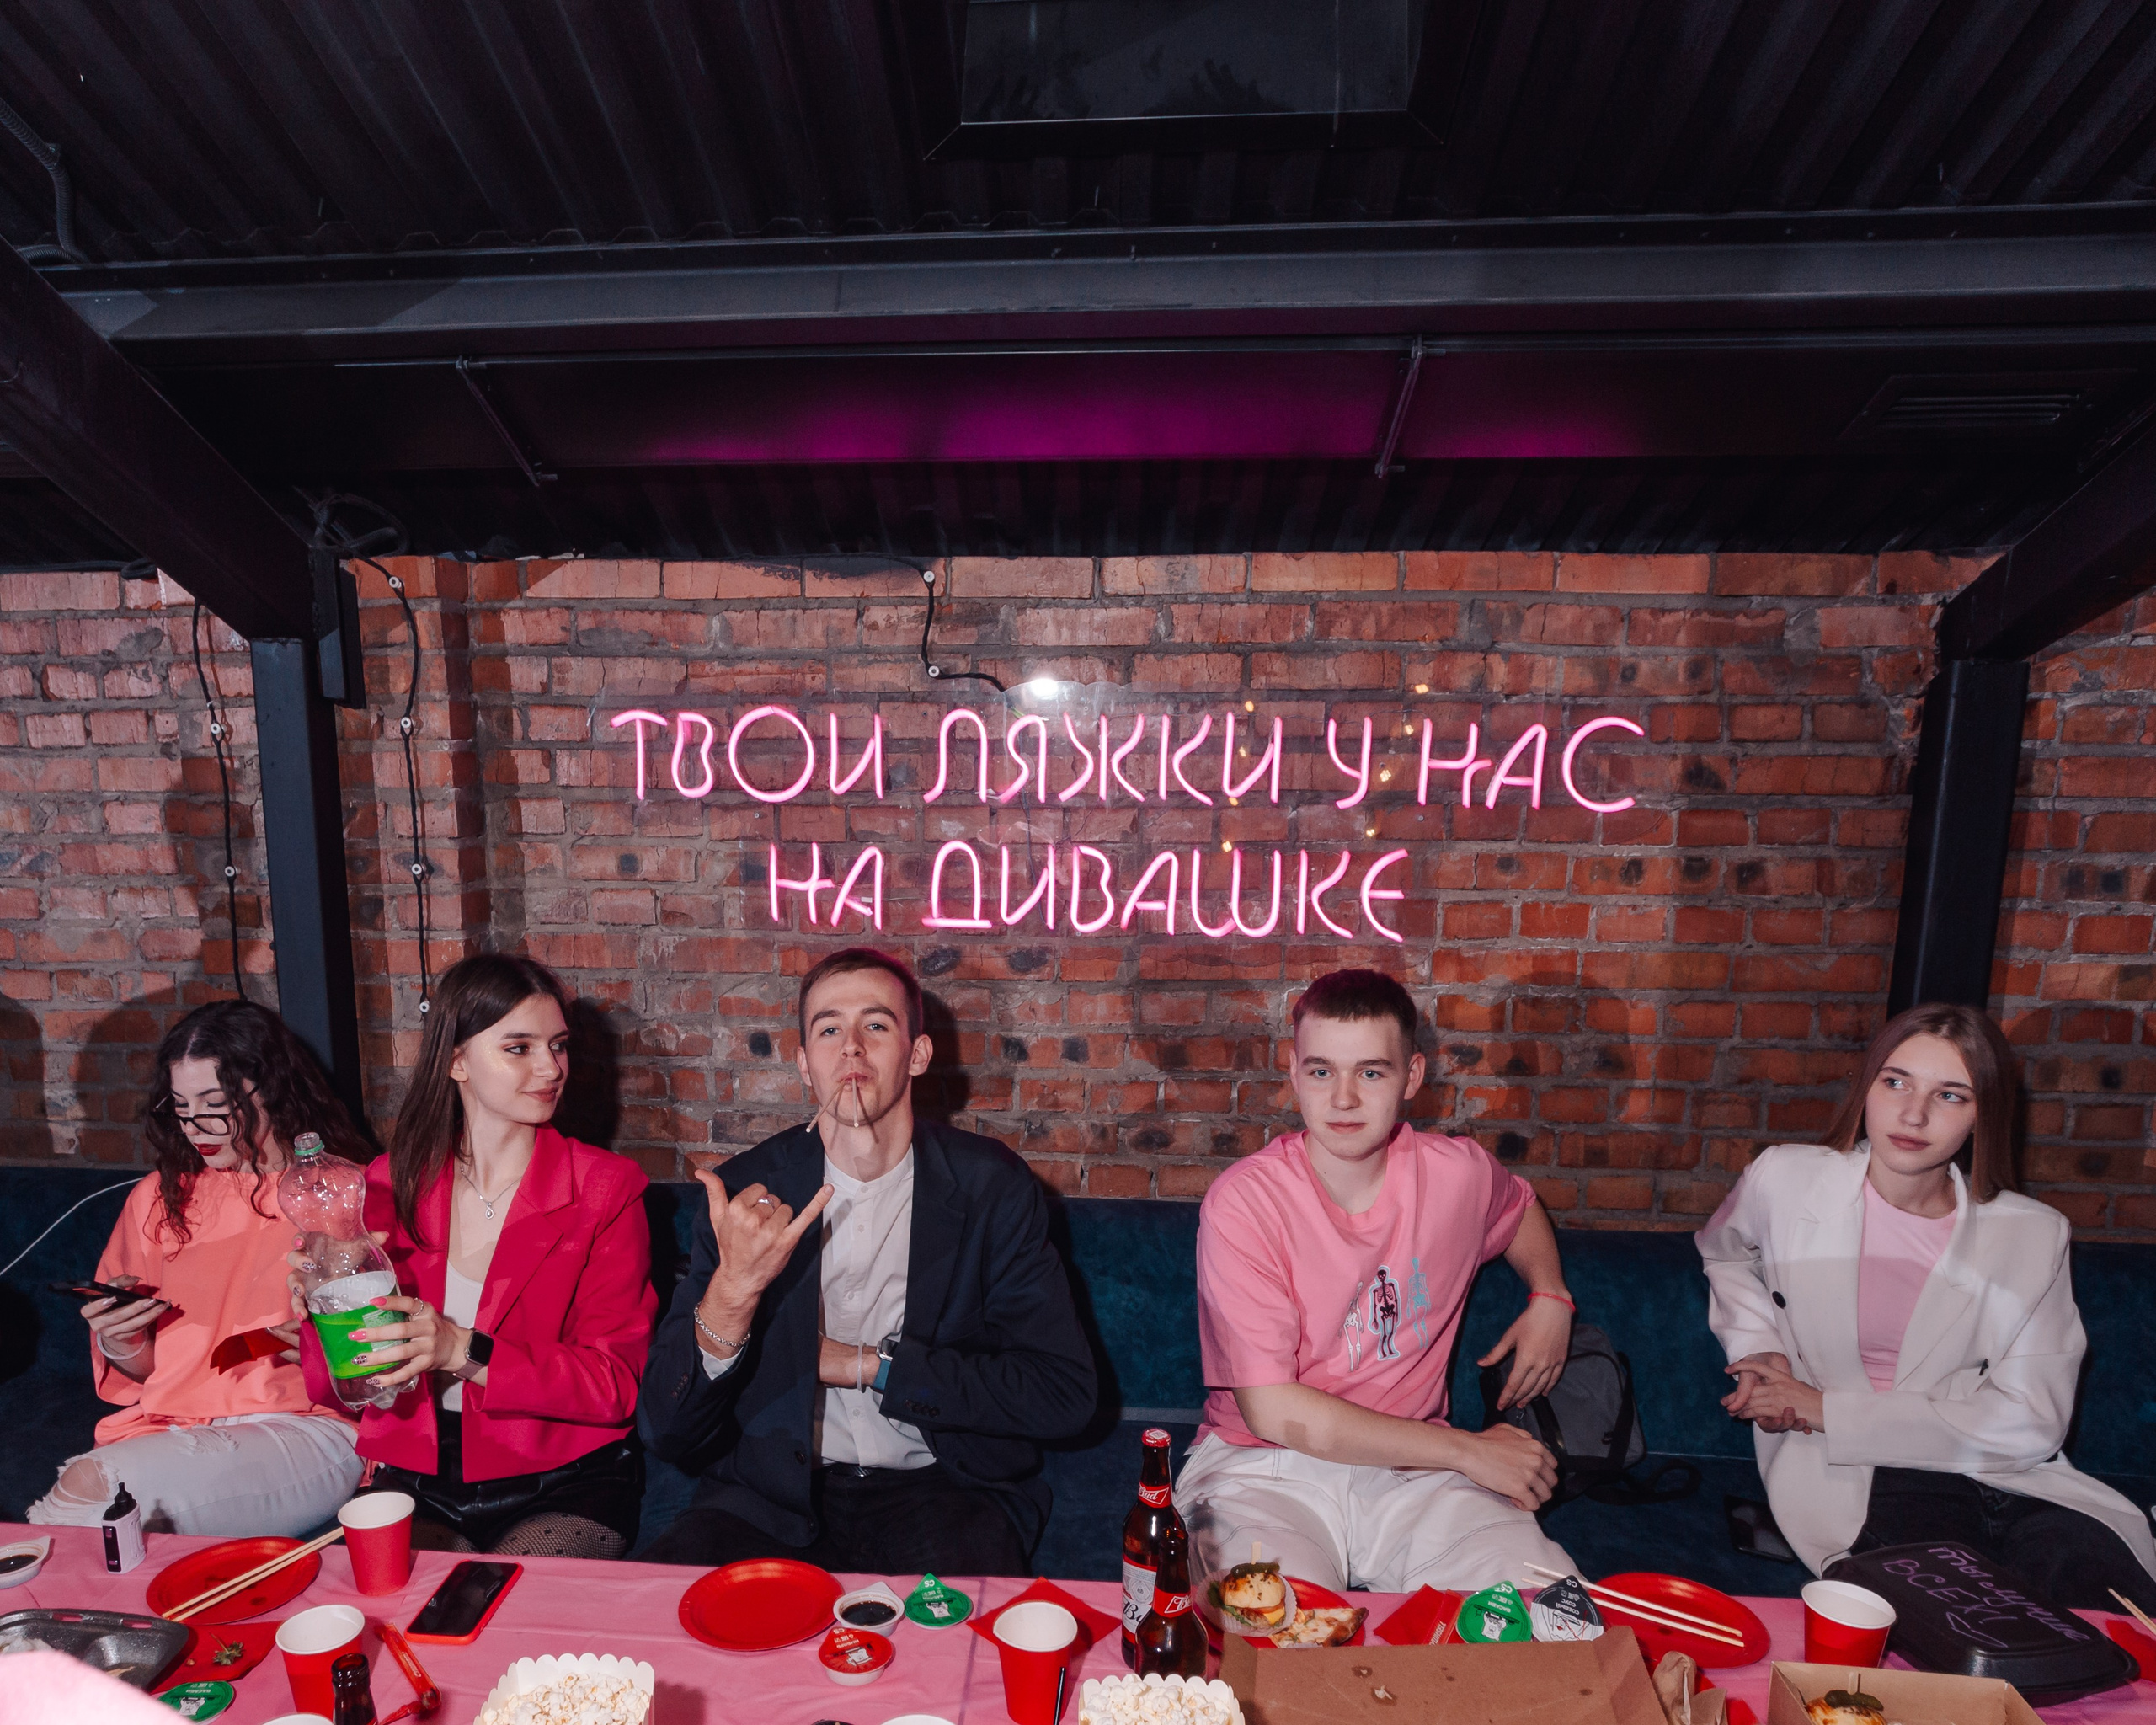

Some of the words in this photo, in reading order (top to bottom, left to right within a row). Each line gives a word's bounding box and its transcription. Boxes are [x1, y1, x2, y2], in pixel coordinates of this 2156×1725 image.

[610, 705, 884, 804] ТВОИ
[923, 708, 1283, 806] ЛЯЖКИ
[1326, 716, 1371, 811] У
[1417, 716, 1646, 812] НАС
[767, 843, 884, 931] НА
[921, 841, 1410, 942] ДИВАШКЕ
[1138, 1486, 1159, 1501] Bud
[924, 1579, 936, 1588] CS
[1566, 1578, 1577, 1589] CS
[1555, 1602, 1580, 1616] СОЕВЫЙ
[1561, 1598, 1577, 1608] СОУС
